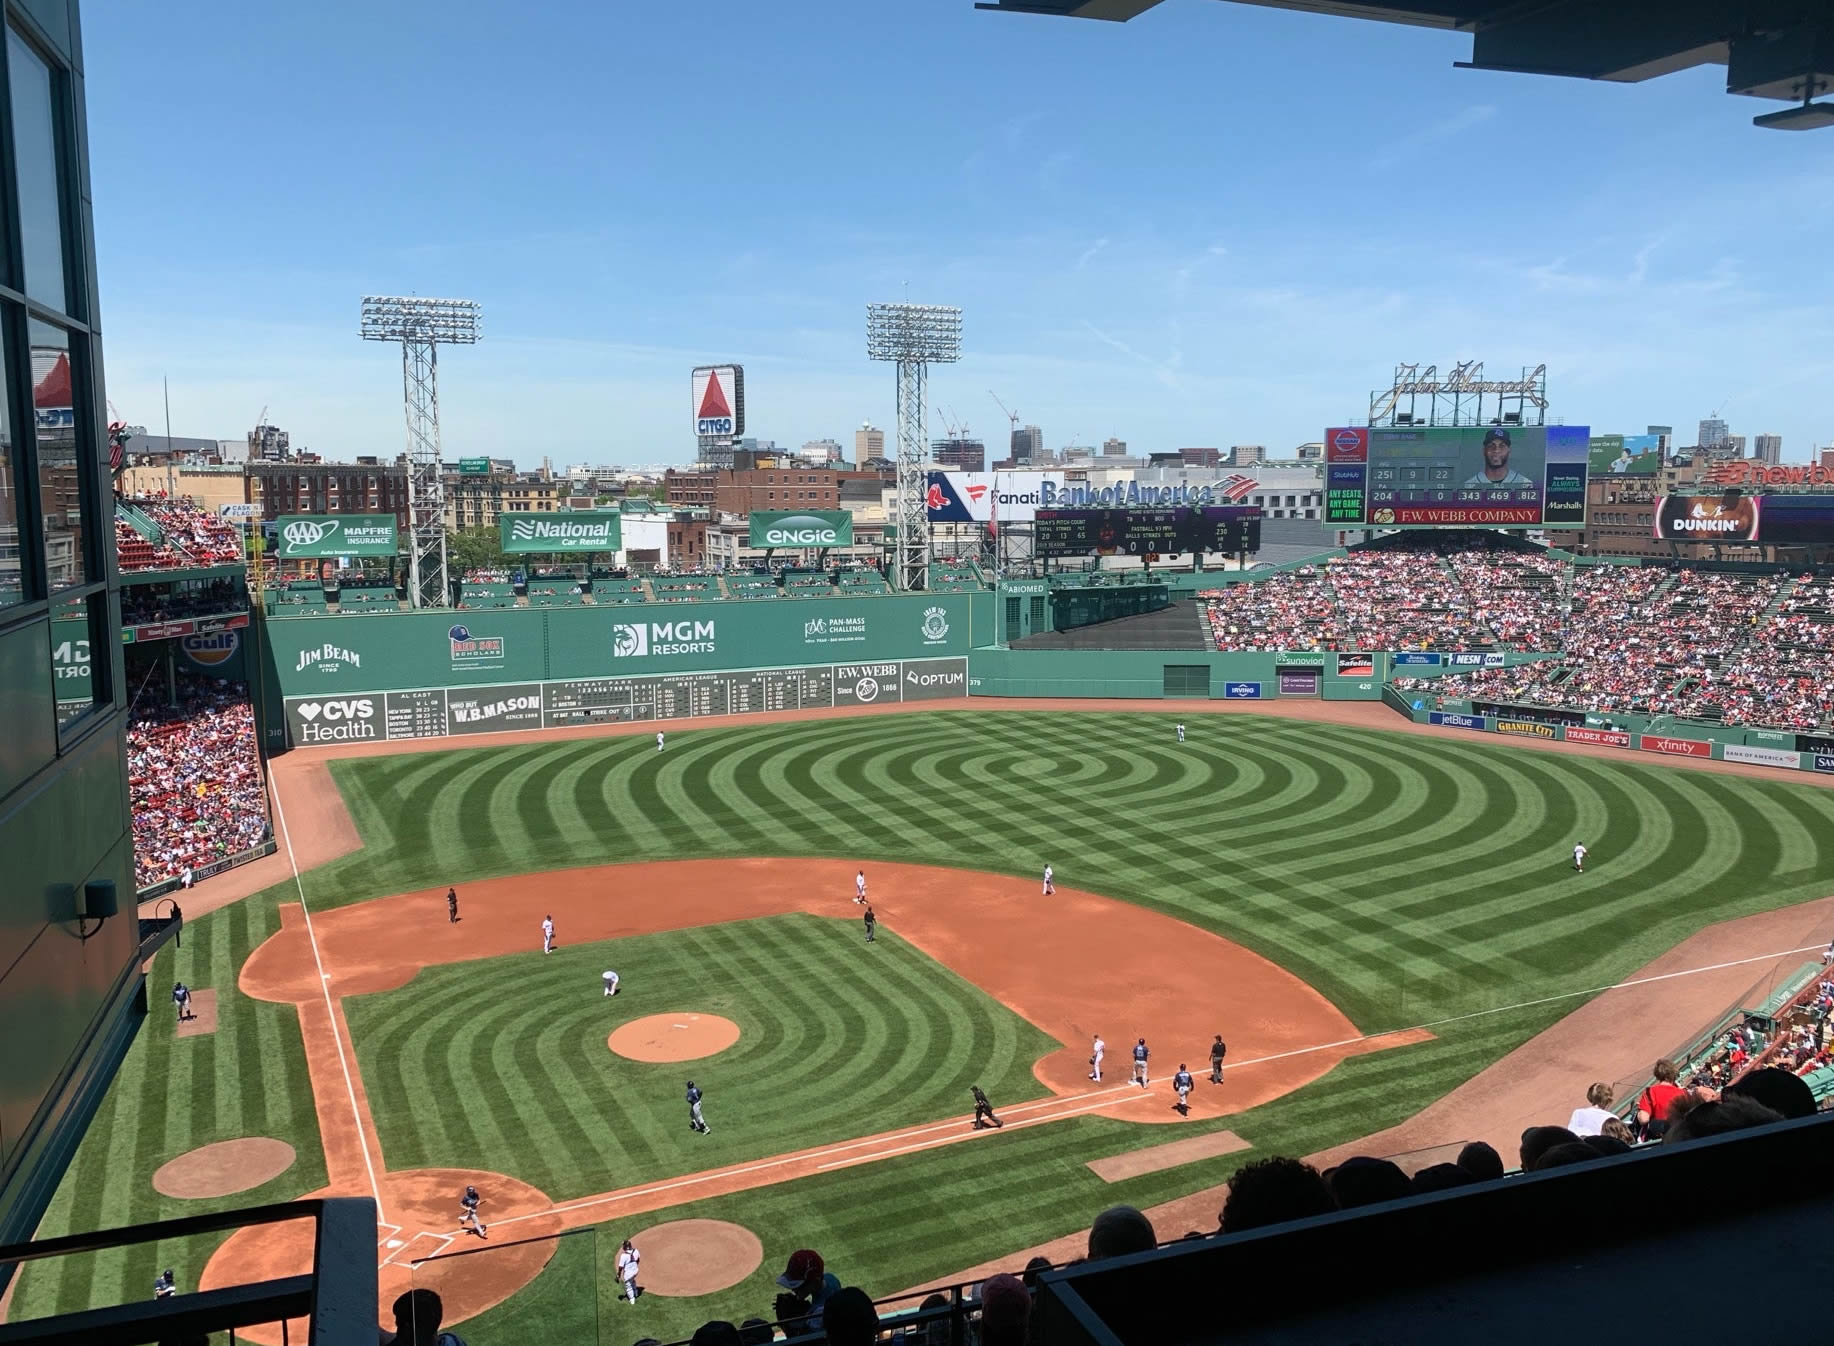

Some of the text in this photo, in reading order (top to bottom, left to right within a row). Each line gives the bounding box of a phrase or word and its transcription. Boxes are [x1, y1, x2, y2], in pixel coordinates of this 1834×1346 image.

[1369, 360, 1549, 422] John Hancock
[698, 418, 732, 434] CITGO
[1374, 471, 1448, 479] .251 9 22
[1752, 460, 1834, 484] new b
[1041, 481, 1098, 505] Bank
[1099, 480, 1122, 505] of
[1123, 480, 1212, 505] America
[1329, 490, 1341, 498] ANY
[1374, 492, 1392, 500] 204
[1458, 492, 1536, 500] .343 .469 .812
[1330, 500, 1341, 508] ANY
[1547, 501, 1582, 509] Marshalls
[1331, 510, 1360, 518] ANY TIME
[1402, 510, 1536, 521] F.W. WEBB COMPANY
[535, 521, 610, 538] National
[1674, 518, 1739, 531] DUNKIN'
[289, 525, 319, 544] AAA
[344, 527, 393, 536] MAPFRE
[347, 537, 390, 545] INSURANCE
[1130, 541, 1154, 552] 0 0
[1008, 584, 1044, 593] ABIOMED
[829, 618, 865, 626] PAN-MASS
[652, 620, 714, 641] MGM
[184, 632, 234, 649] Gulf
[454, 640, 500, 652] RED SOX
[652, 642, 714, 656] RESORTS
[296, 644, 360, 672] JIM BEAM
[1286, 656, 1324, 664] sunovion
[1456, 655, 1482, 664] NESN
[838, 665, 897, 678] F.W. WEBB
[920, 673, 963, 686] OPTUM
[323, 700, 374, 720] CVS
[454, 696, 540, 722] W.B.MASON
[1441, 715, 1473, 726] jetBlue
[302, 720, 376, 742] Health
[1498, 722, 1535, 732] GRANITE
[1535, 726, 1554, 737] CITY
[1568, 731, 1628, 744] TRADER JOE'S
[1657, 740, 1695, 753] xfinity
[200, 866, 217, 878] TRULY
